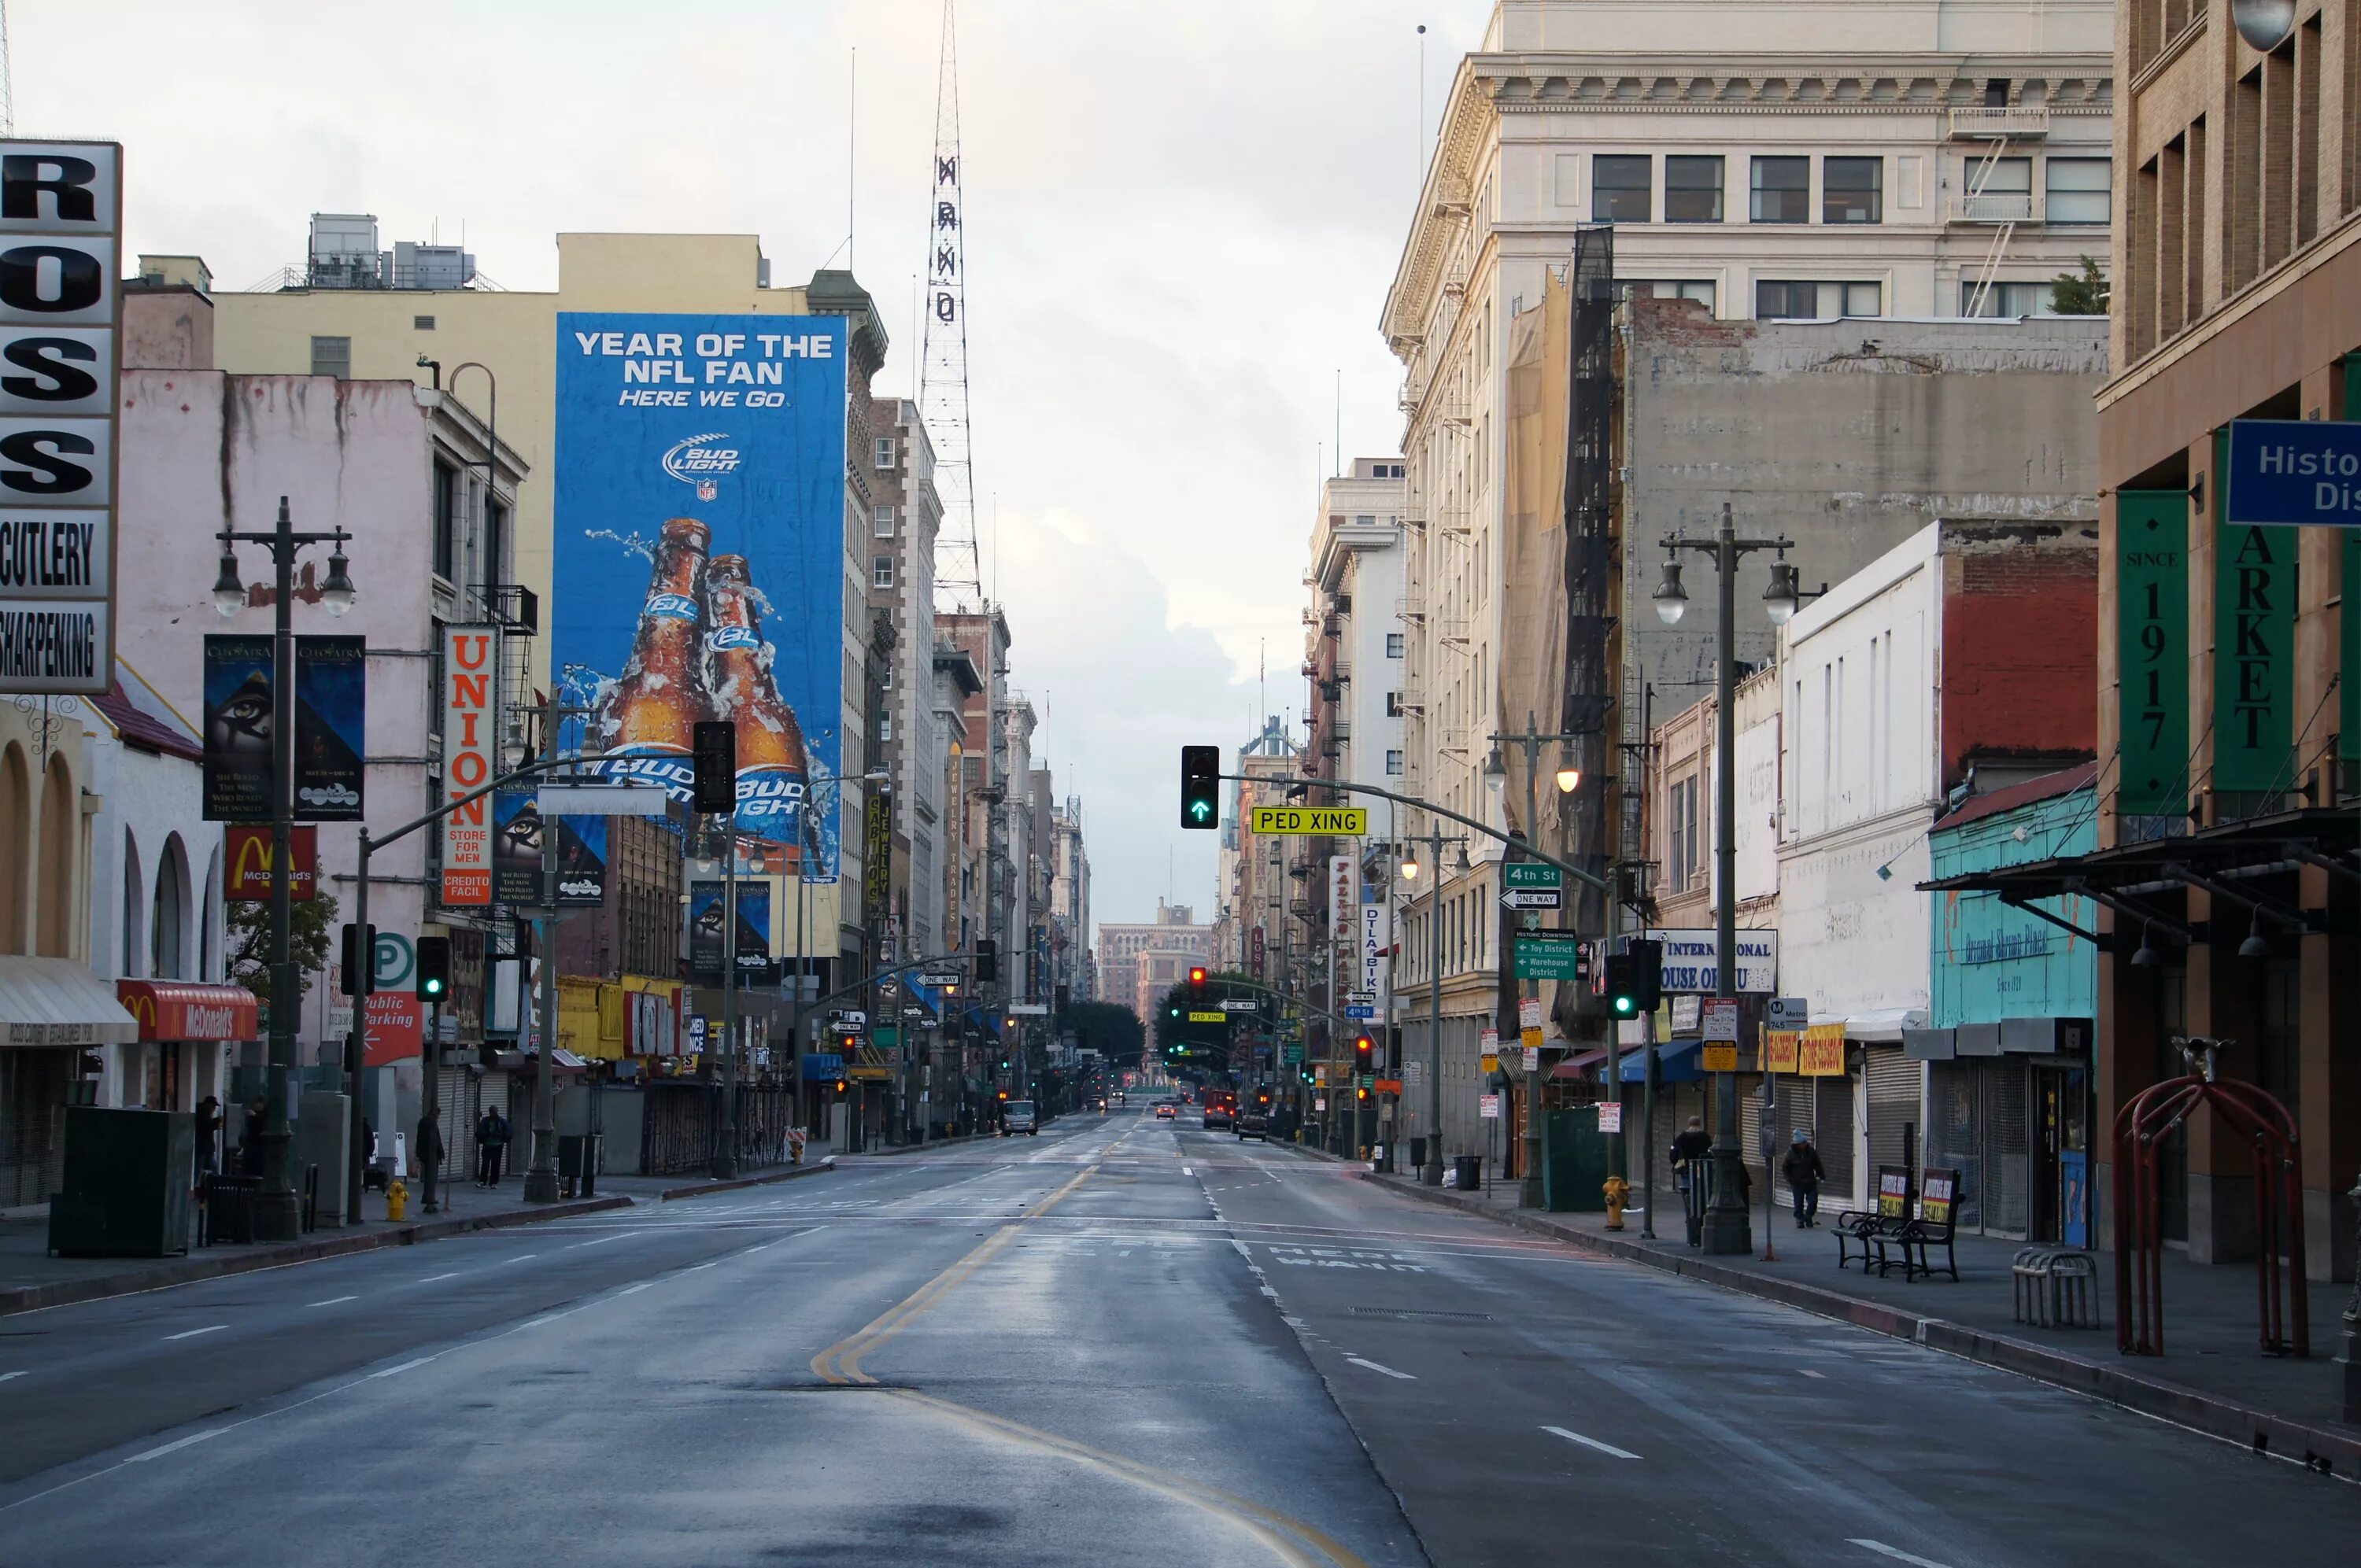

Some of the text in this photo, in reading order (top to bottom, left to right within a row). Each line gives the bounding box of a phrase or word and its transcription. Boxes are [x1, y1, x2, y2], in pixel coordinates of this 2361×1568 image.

[2, 154, 101, 494] ROSS
[575, 333, 832, 358] YEAR OF THE
[624, 360, 782, 385] NFL FAN
[619, 390, 785, 408] HERE WE GO
[685, 449, 738, 459] BUD
[2260, 445, 2359, 476] Histo
[672, 460, 741, 470] LIGHT
[699, 489, 715, 498] NFL
[0, 521, 94, 587] CUTLERY
[2126, 552, 2178, 566] SINCE
[2234, 525, 2275, 749] ARKET
[2141, 582, 2166, 751] 1917
[449, 636, 490, 825] UNION
[736, 780, 808, 799] BUD
[950, 759, 959, 843] JEWELRY
[1261, 812, 1357, 830] PED XING
[450, 831, 486, 840] STORE
[456, 843, 478, 851] FOR
[880, 806, 889, 894] JEWELRY
[455, 854, 479, 863] MEN
[244, 871, 312, 880] McDld's
[445, 876, 489, 886] CREDITO
[1511, 868, 1556, 880] 4th St
[451, 887, 482, 896] FACIL
[948, 854, 957, 924] TRADES
[1366, 909, 1379, 948] DTLA
[1531, 945, 1572, 954] Toy District
[1668, 943, 1771, 957] INTERNONAL
[375, 944, 397, 975] P
[1530, 958, 1568, 967] Warehouse
[1661, 967, 1698, 989] OUSE
[1705, 1005, 1714, 1014] NO
[186, 1005, 233, 1037] McDonald's
